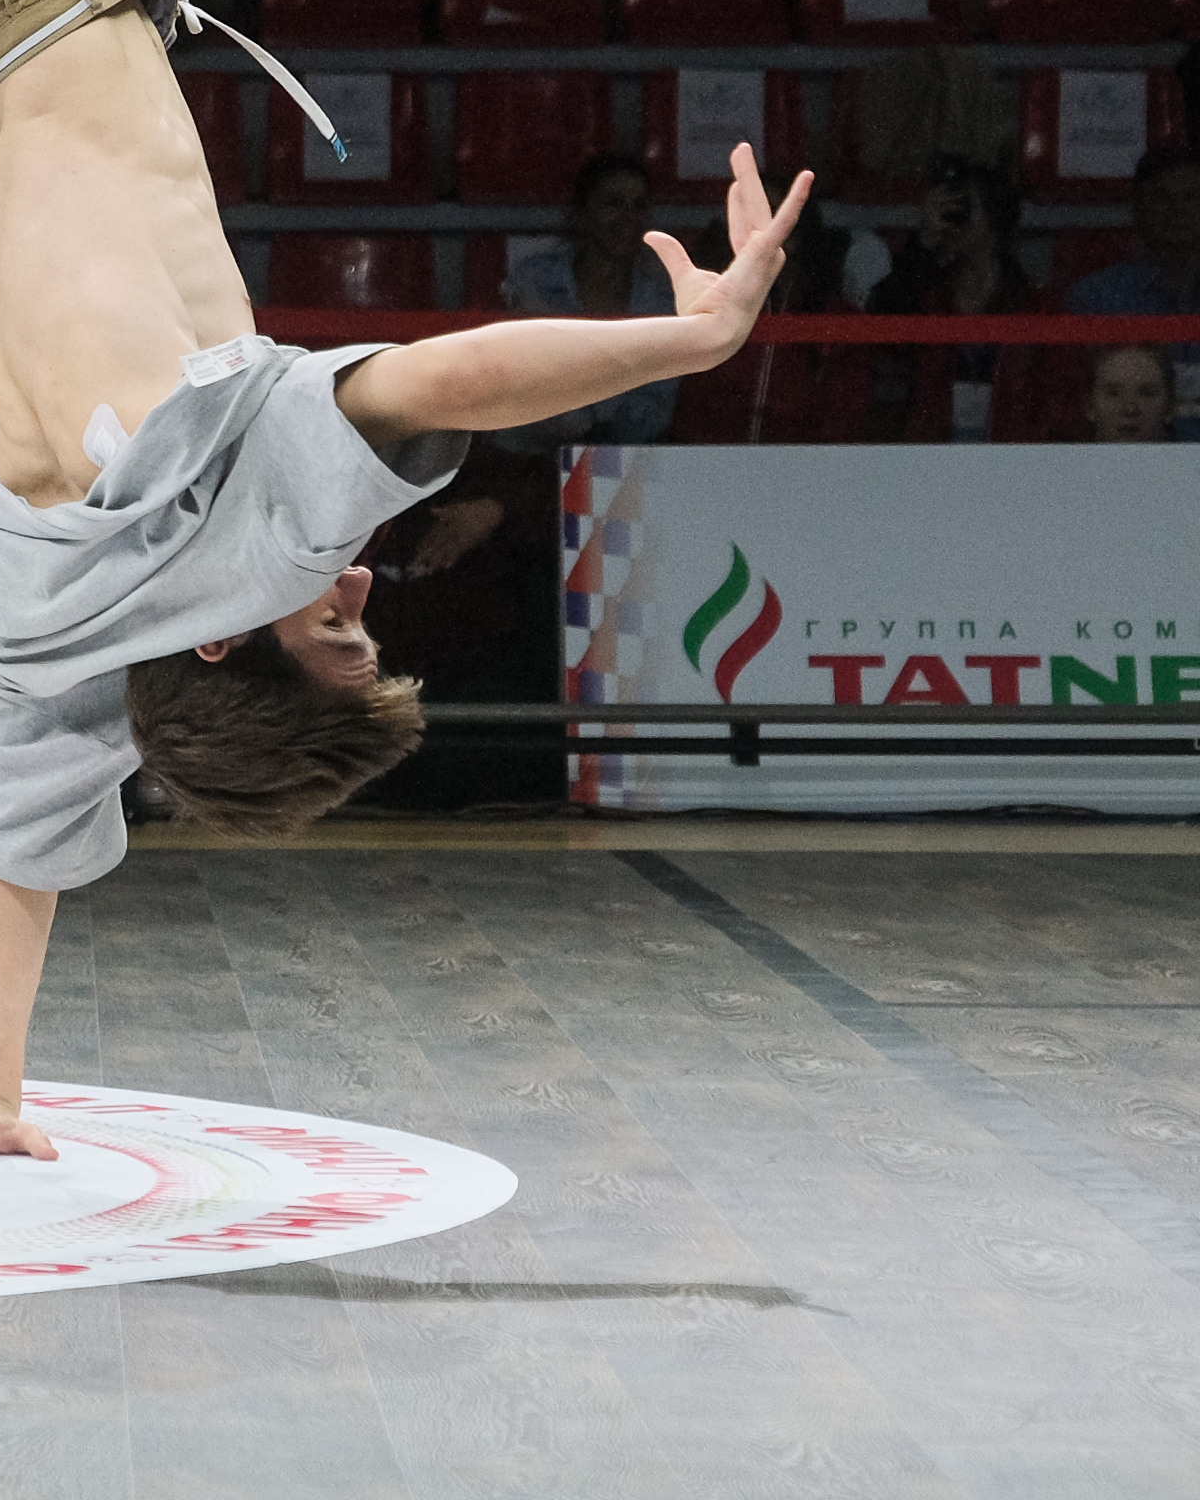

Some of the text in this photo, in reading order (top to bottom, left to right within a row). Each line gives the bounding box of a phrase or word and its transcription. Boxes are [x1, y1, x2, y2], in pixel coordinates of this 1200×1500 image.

[805, 619, 1177, 640] ГРУППА КОМ
[206, 1126, 428, 1175] ФИНАЛ
[130, 1191, 414, 1251] ФИНАЛ
